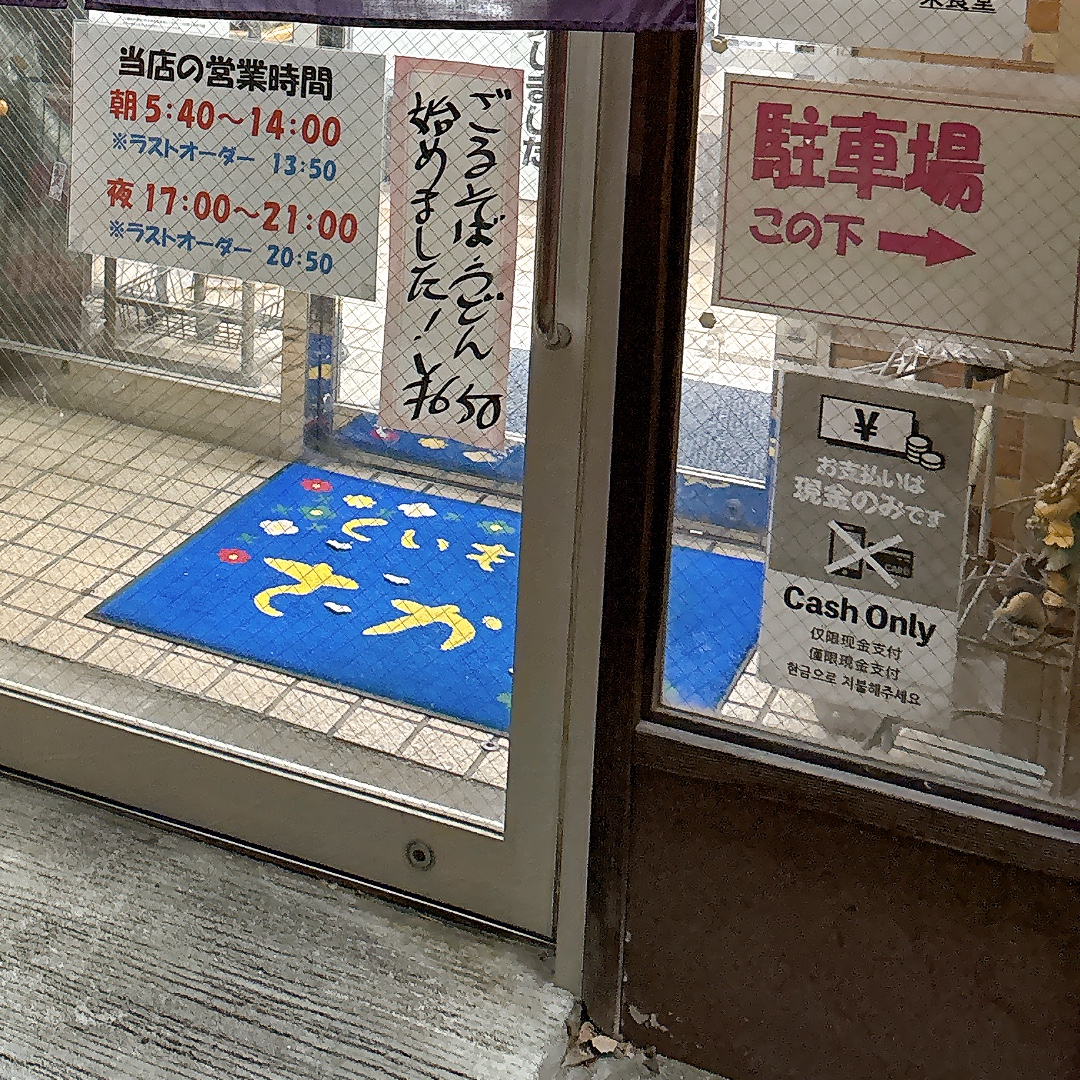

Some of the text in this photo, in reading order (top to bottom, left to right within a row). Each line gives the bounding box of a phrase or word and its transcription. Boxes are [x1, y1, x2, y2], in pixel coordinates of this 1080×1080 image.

[118, 45, 333, 101] 当店の営業時間
[272, 152, 337, 182] 13:50
[751, 102, 985, 213] 駐車場
[749, 207, 865, 256] この下
[266, 244, 334, 275] 20:50
[816, 456, 926, 494] お支払いは
[793, 476, 946, 529] 現金のみです
[783, 585, 937, 647] Cash Only
